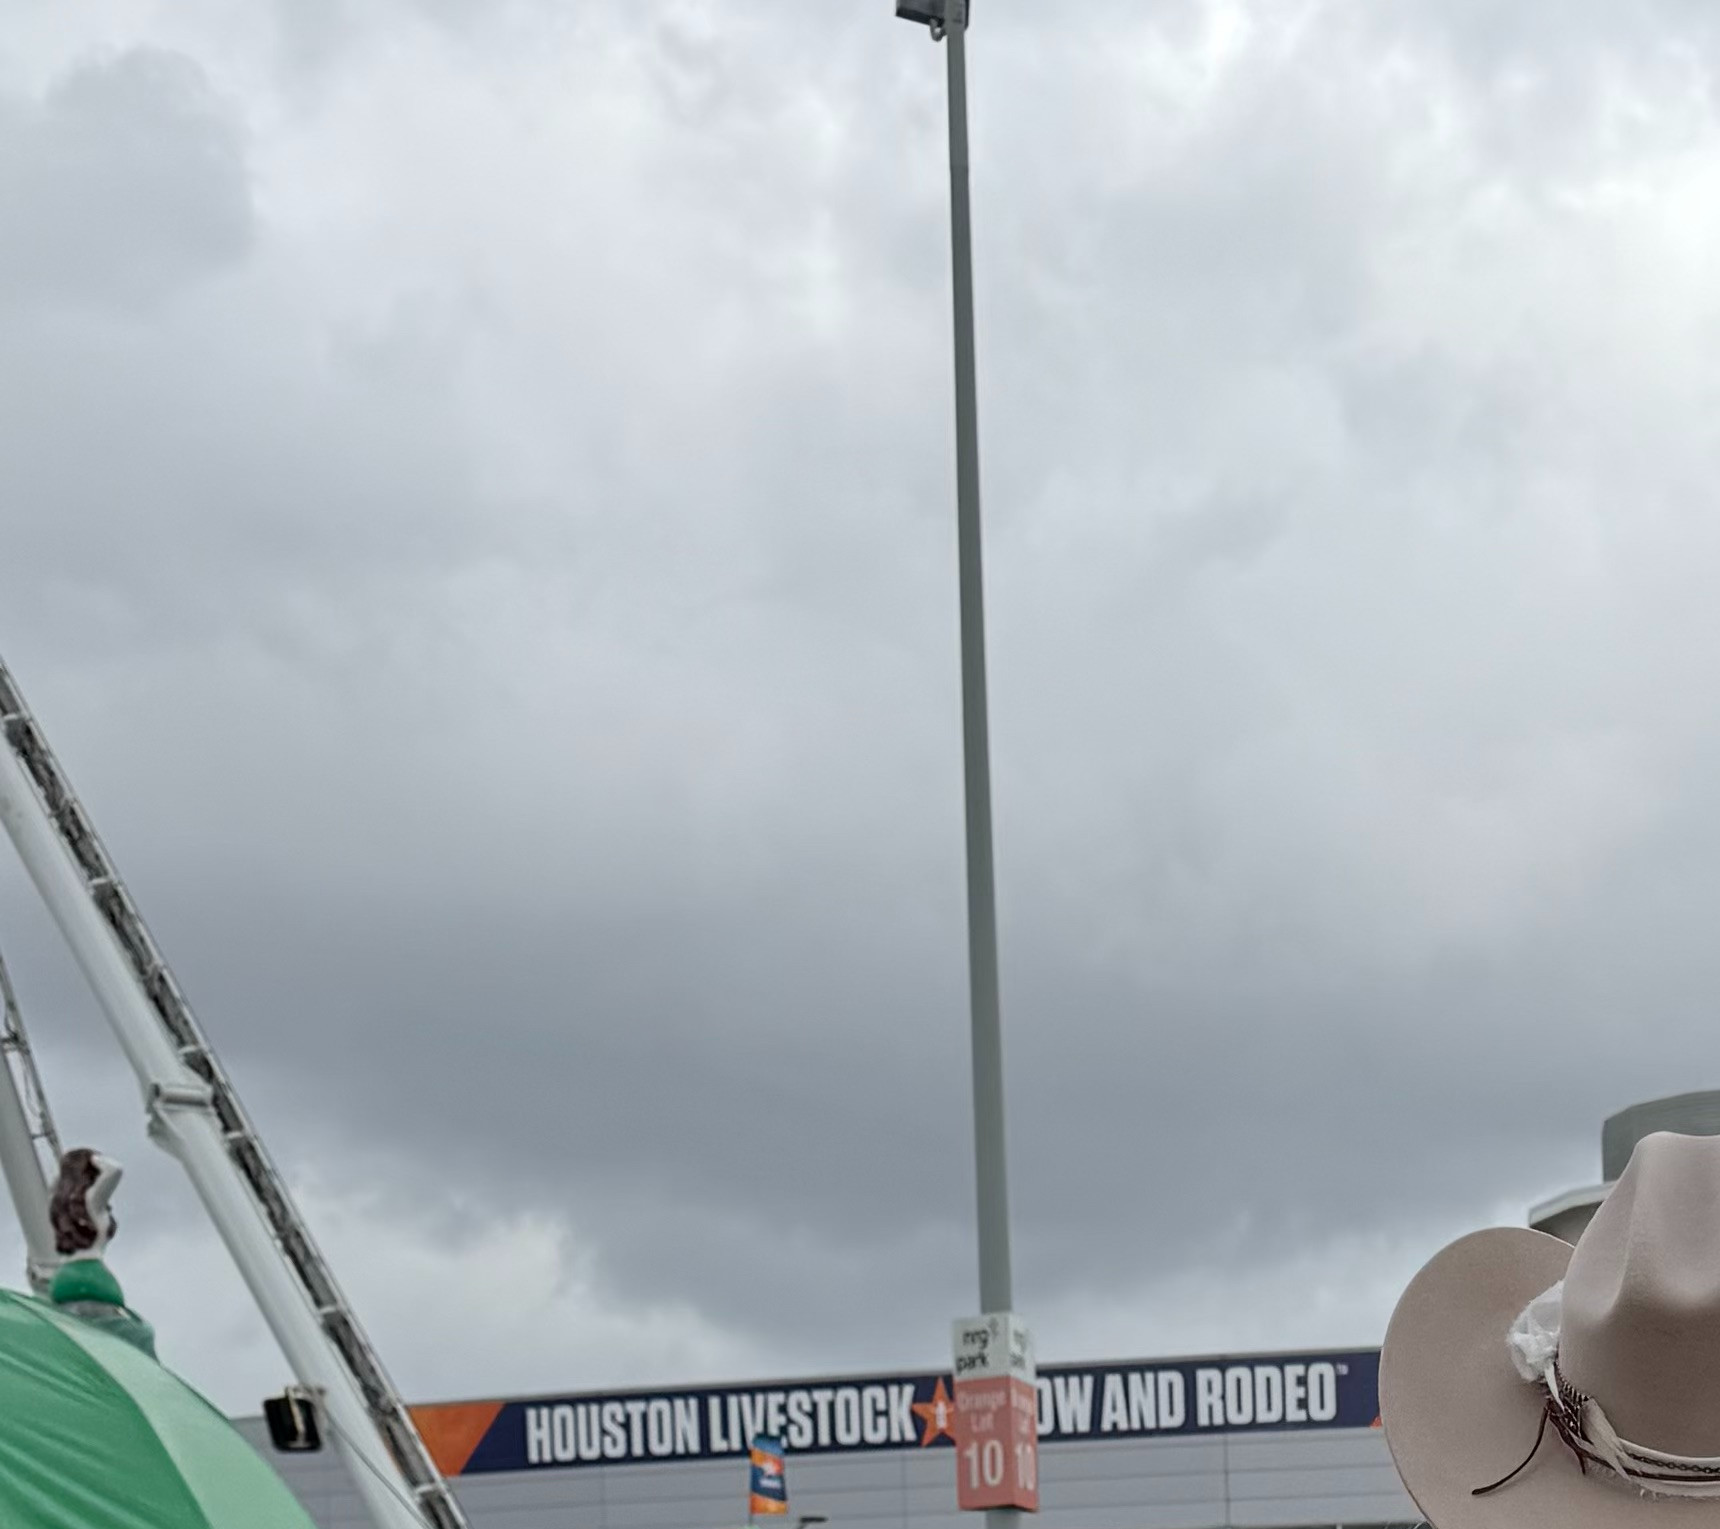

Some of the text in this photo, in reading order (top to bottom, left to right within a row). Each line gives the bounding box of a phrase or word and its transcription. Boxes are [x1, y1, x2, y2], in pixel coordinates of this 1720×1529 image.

[956, 1353, 989, 1374] park
[963, 1329, 989, 1349] nrg
[1100, 1369, 1186, 1432] AND
[1195, 1362, 1338, 1427] RODEO
[525, 1383, 918, 1464] HOUSTON LIVESTOCK
[964, 1439, 1004, 1489] 10
